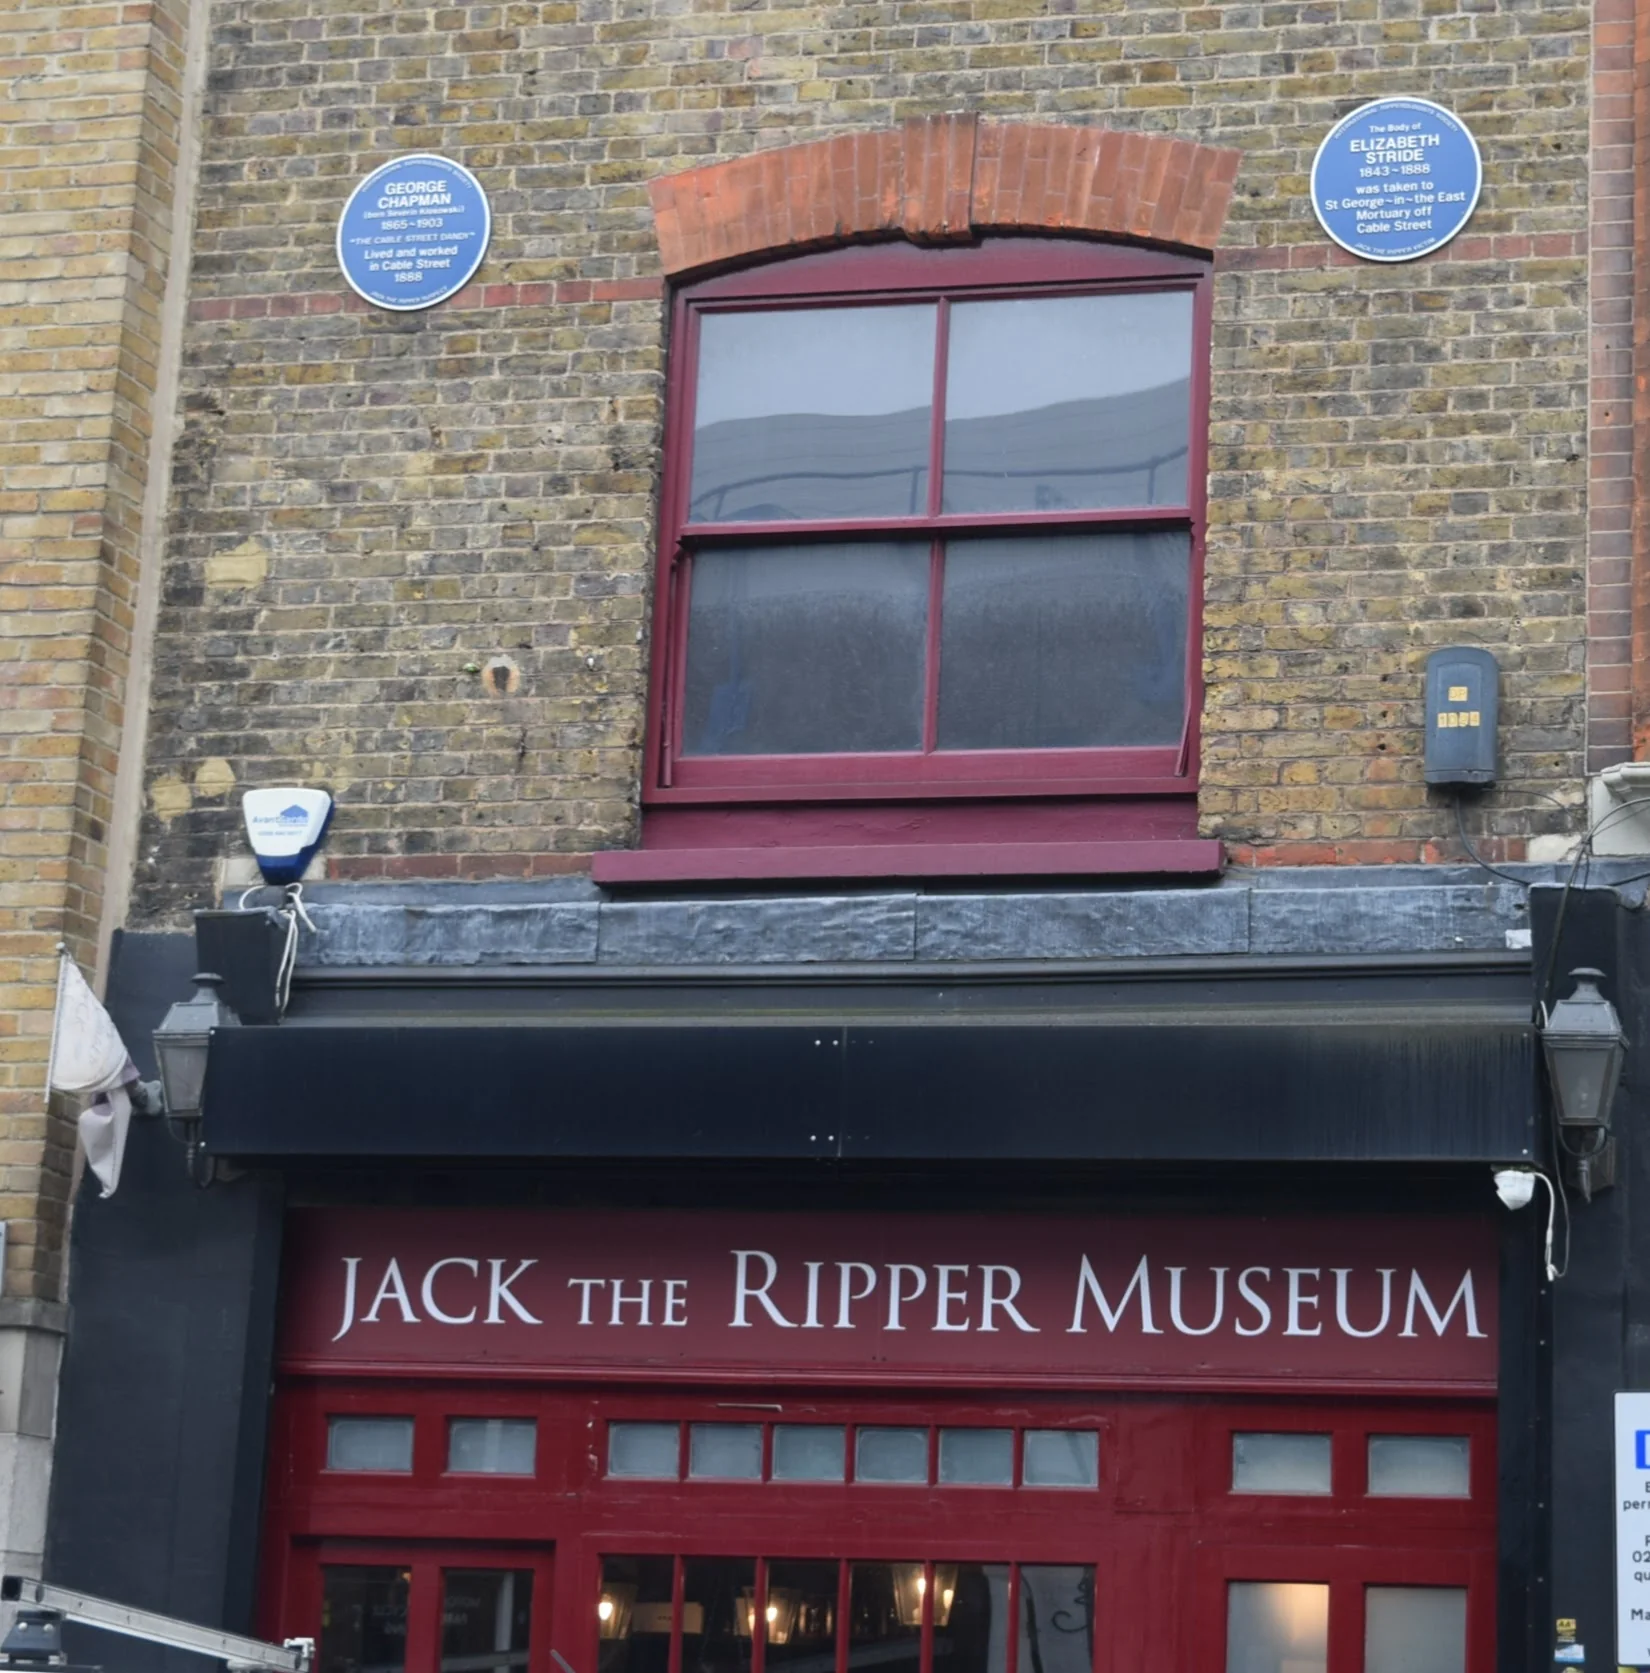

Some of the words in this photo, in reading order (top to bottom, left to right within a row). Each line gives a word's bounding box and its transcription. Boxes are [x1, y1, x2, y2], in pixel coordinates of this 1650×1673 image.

[1368, 125, 1386, 134] The
[1388, 124, 1410, 134] Body
[1411, 122, 1422, 130] of
[1350, 134, 1440, 152] ELIZABETH
[1365, 149, 1424, 164] STRIDE
[384, 180, 447, 195] GEORGE
[1356, 184, 1379, 194] was
[1383, 182, 1418, 193] taken
[1421, 180, 1434, 190] to
[378, 193, 451, 209] CHAPMAN
[1325, 199, 1338, 210] St
[1438, 191, 1466, 202] East
[1356, 208, 1410, 221] Mortuary
[1414, 206, 1432, 216] off
[1357, 221, 1390, 234] Cable
[1394, 220, 1432, 232] Street
[364, 249, 393, 260] Lived
[396, 248, 416, 258] and
[419, 245, 458, 256] worked
[369, 261, 379, 271] in
[382, 259, 413, 271] Cable
[416, 258, 450, 268] Street
[394, 272, 422, 282] 1888
[332, 1257, 543, 1342] JACK
[567, 1278, 688, 1327] THE
[728, 1250, 1041, 1333] RIPPER
[1066, 1252, 1488, 1338] MUSEUM
